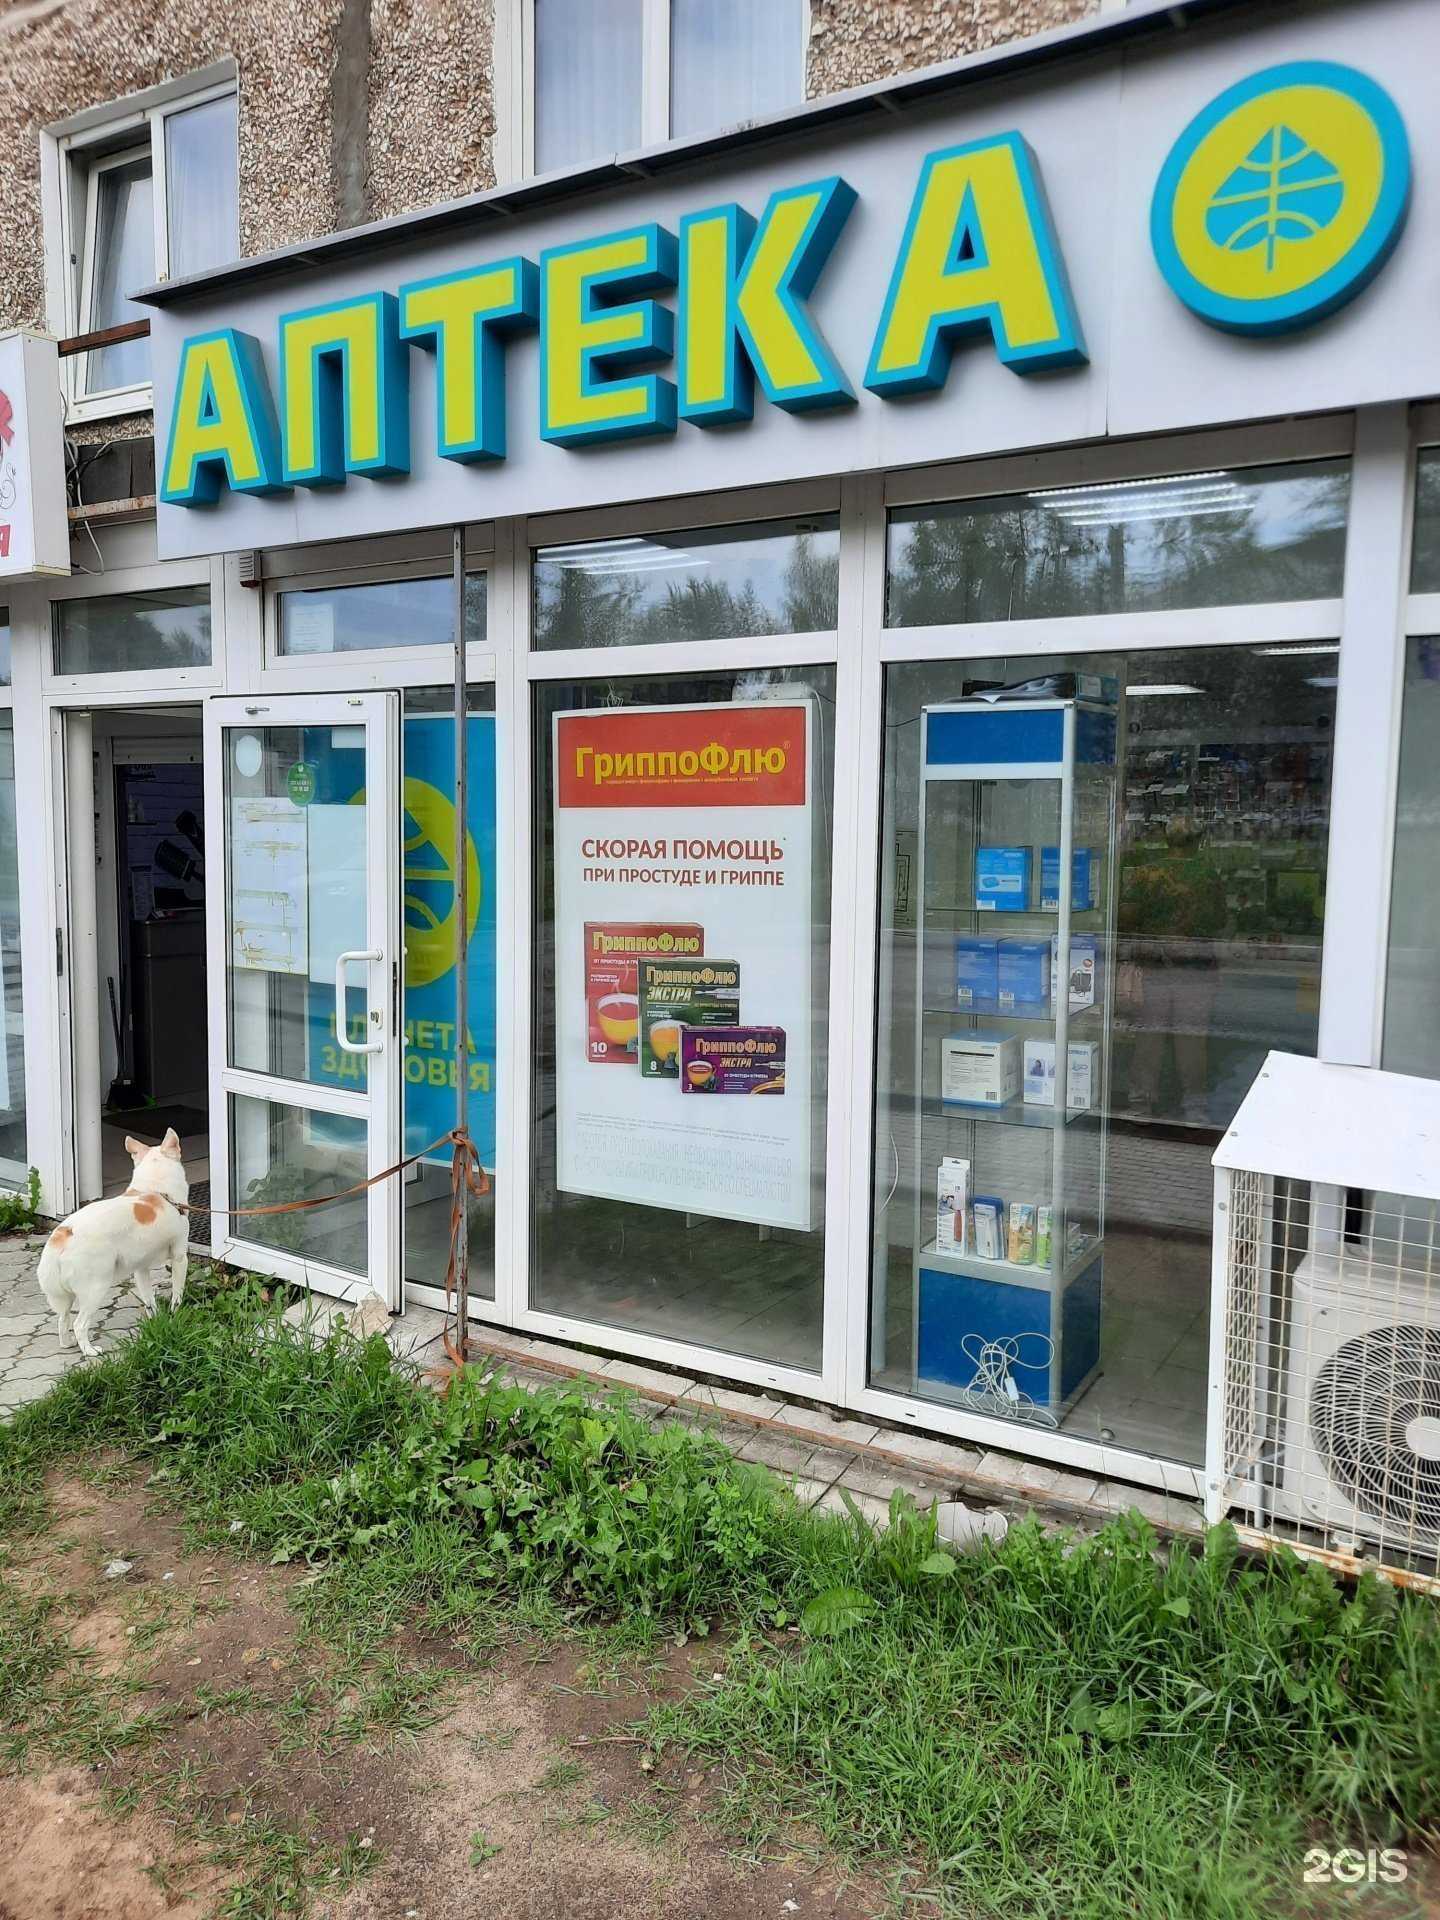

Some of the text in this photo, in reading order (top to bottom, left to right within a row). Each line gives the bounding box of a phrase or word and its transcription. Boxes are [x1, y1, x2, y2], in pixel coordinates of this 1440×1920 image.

[160, 130, 1090, 508] АПТЕКА
[575, 742, 786, 785] ГриппоФлю
[581, 839, 784, 865] СКОРАЯ ПОМОЩЬ
[583, 867, 785, 887] ПРИ ПРОСТУДЕ И ГРИППЕ
[592, 931, 700, 955] ГриппоФлю
[646, 965, 737, 986] ГриппоФлю
[646, 986, 692, 1001] ЭКСТРА
[591, 1041, 608, 1054] 10
[695, 1038, 777, 1055] ГриппоФлю
[321, 1044, 490, 1093] ЗДОВЯ
[650, 1060, 657, 1071] 8
[719, 1057, 753, 1069] ЭКСТРА
